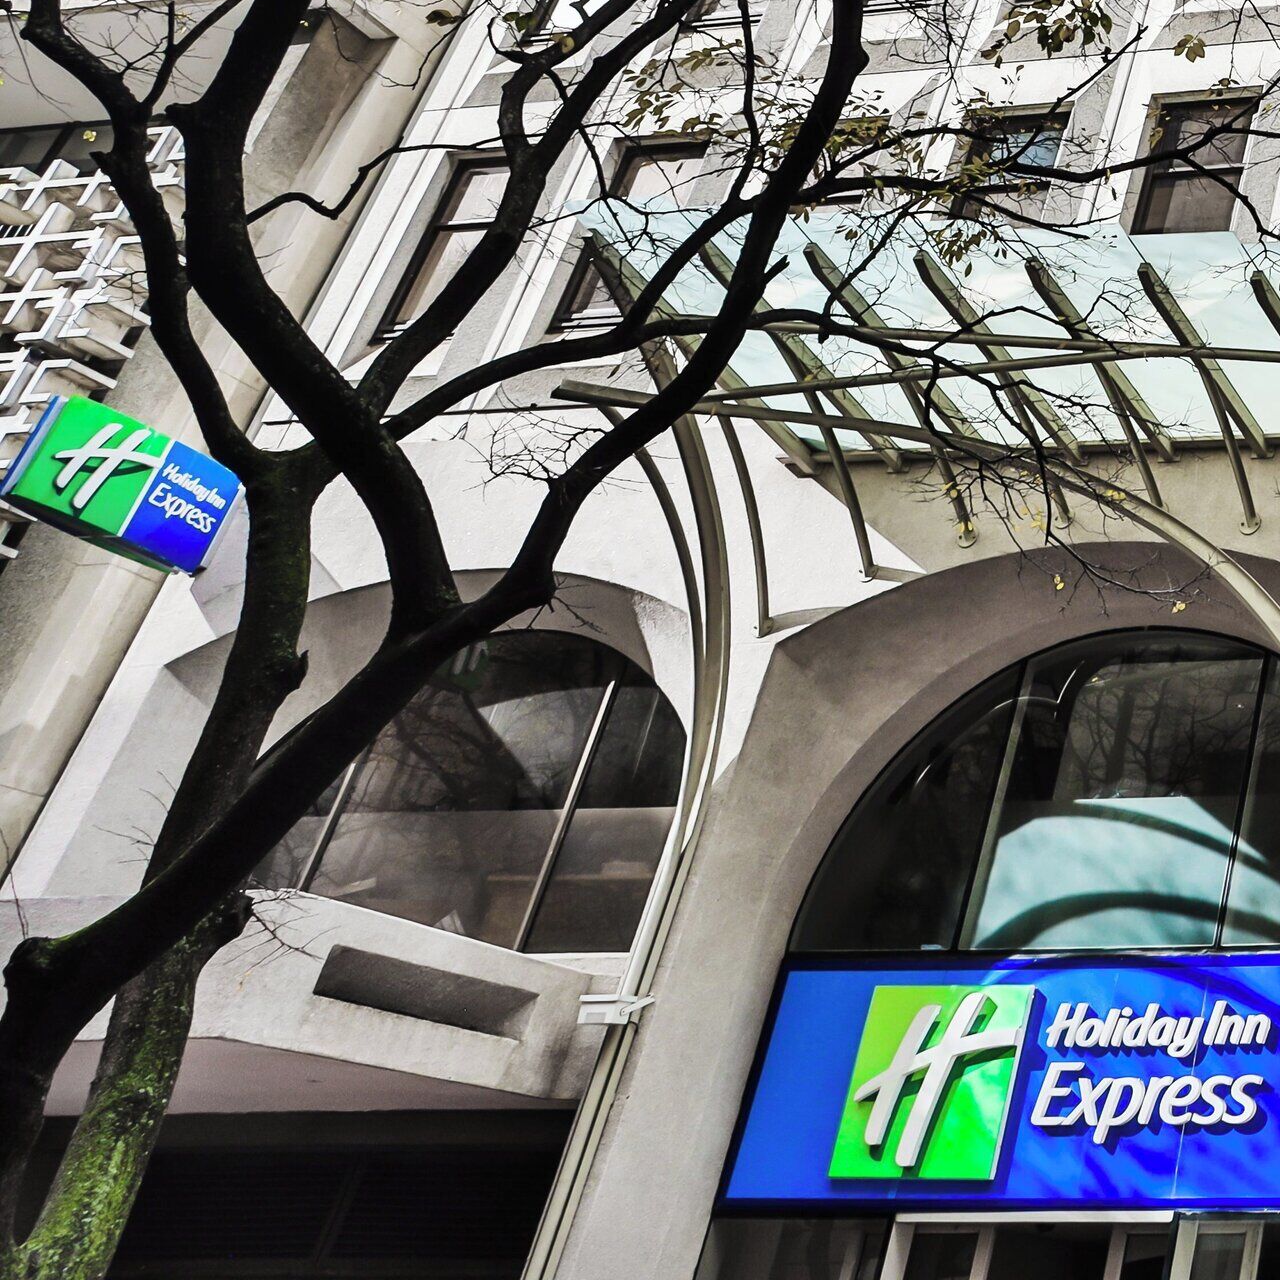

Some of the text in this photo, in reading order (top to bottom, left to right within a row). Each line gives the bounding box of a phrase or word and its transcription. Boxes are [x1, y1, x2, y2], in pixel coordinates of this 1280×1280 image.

[148, 483, 217, 534] Express
[162, 463, 227, 510] Holiday Inn
[1045, 1000, 1272, 1058] Holiday Inn
[1030, 1061, 1264, 1145] Express
